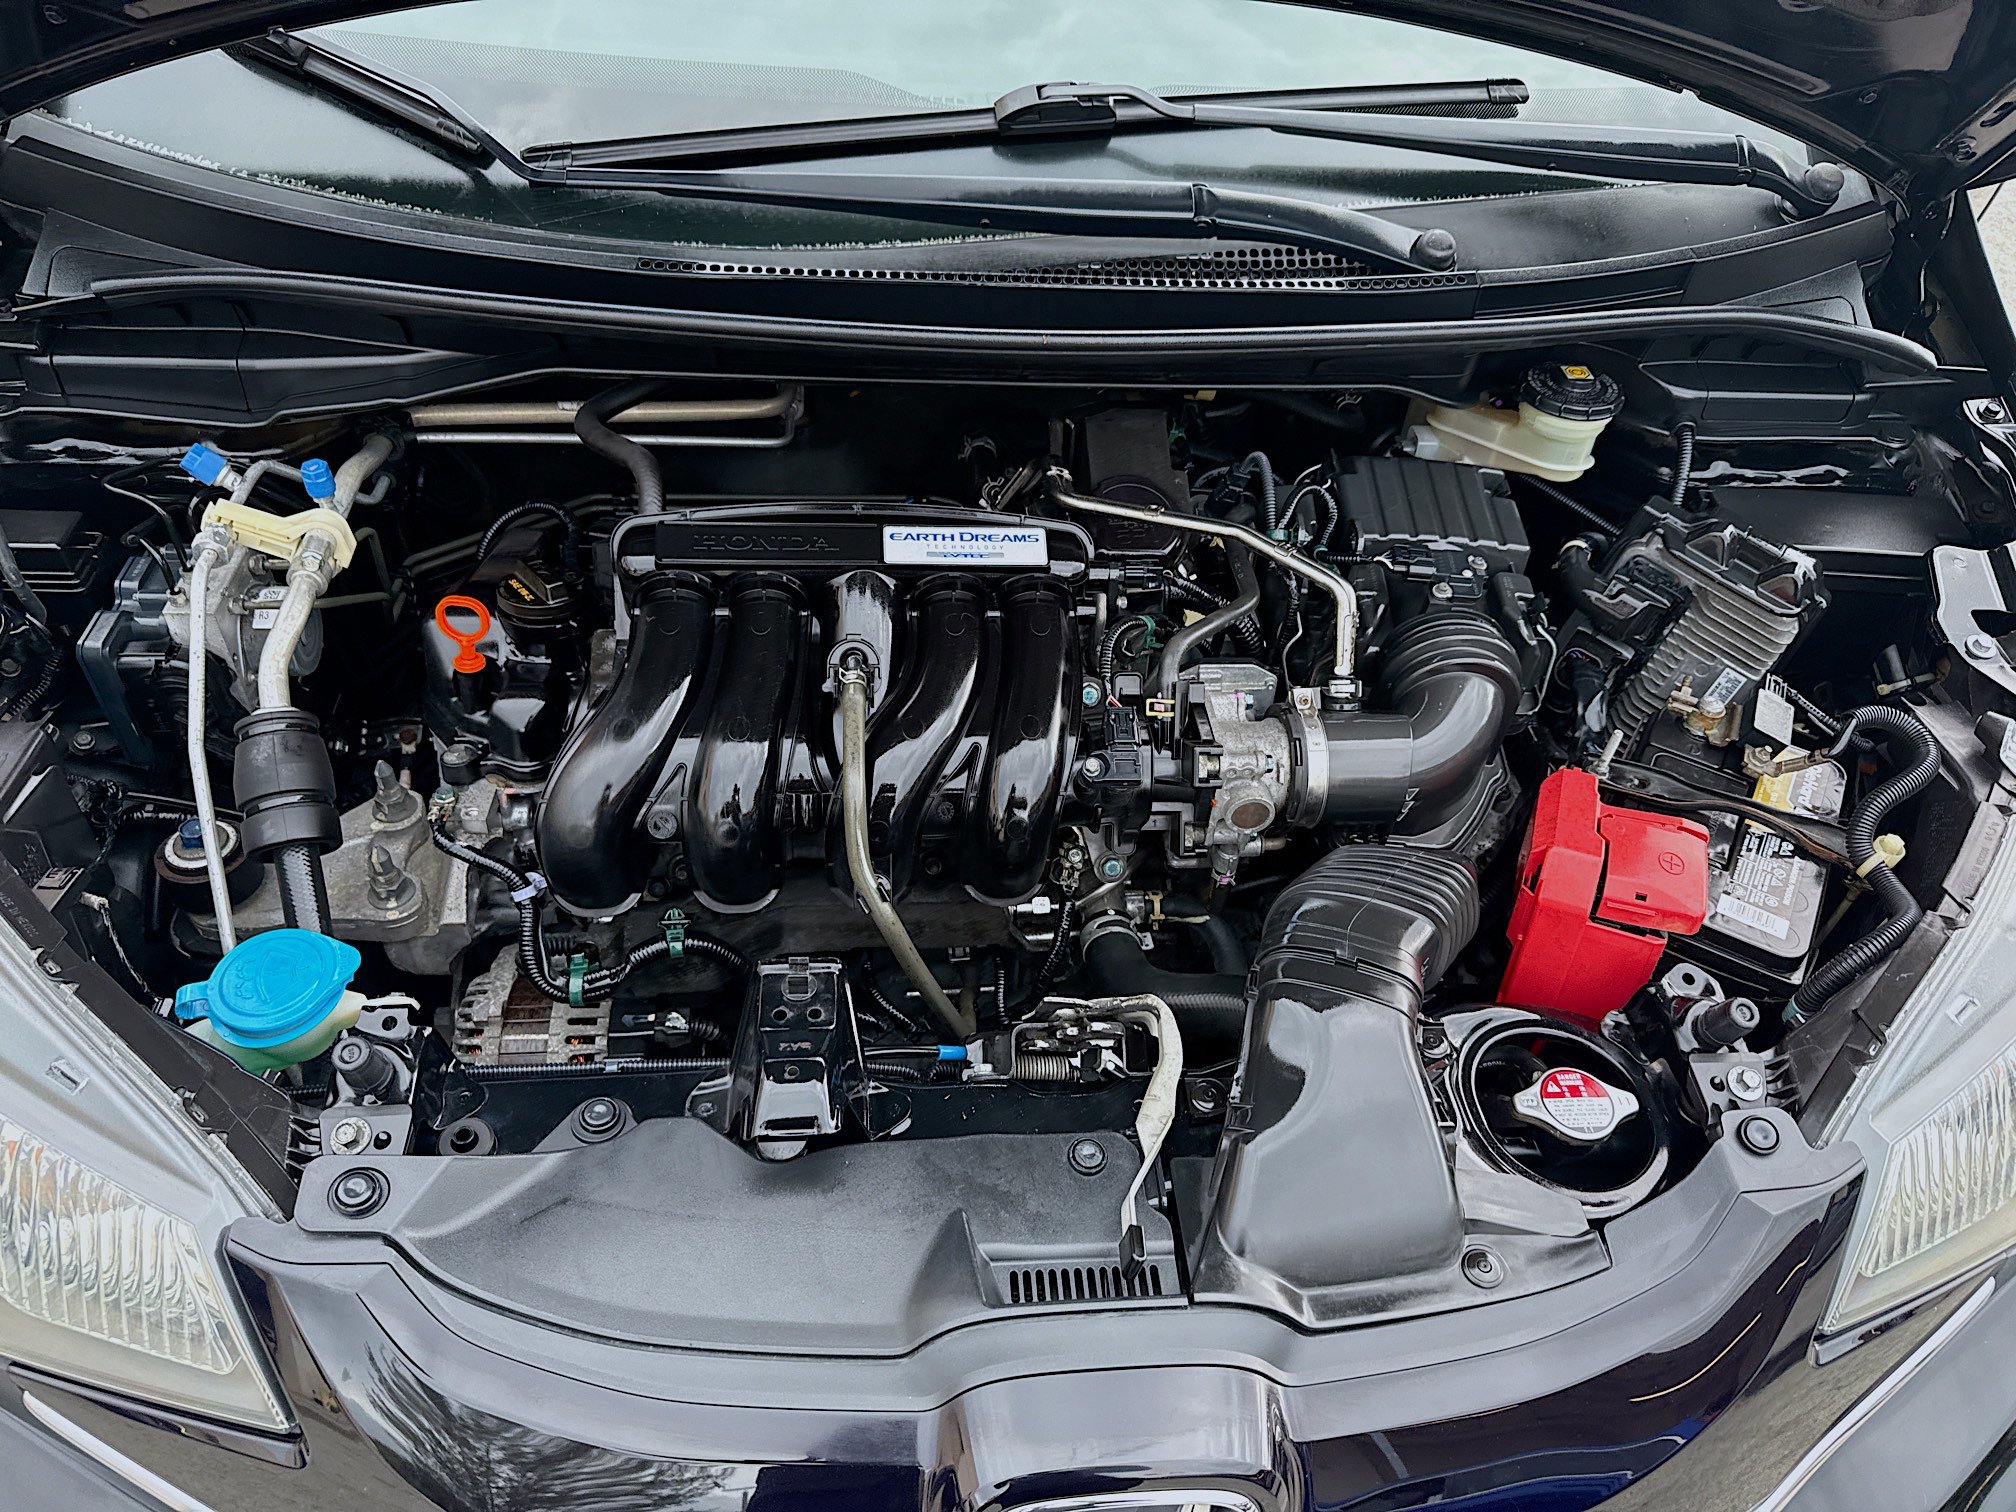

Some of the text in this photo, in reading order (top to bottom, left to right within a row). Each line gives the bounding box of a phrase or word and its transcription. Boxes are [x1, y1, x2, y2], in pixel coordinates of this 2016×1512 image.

[693, 534, 840, 551] HONDA
[889, 532, 1040, 543] EARTH DREAMS
[1797, 765, 1822, 808] DieHard
